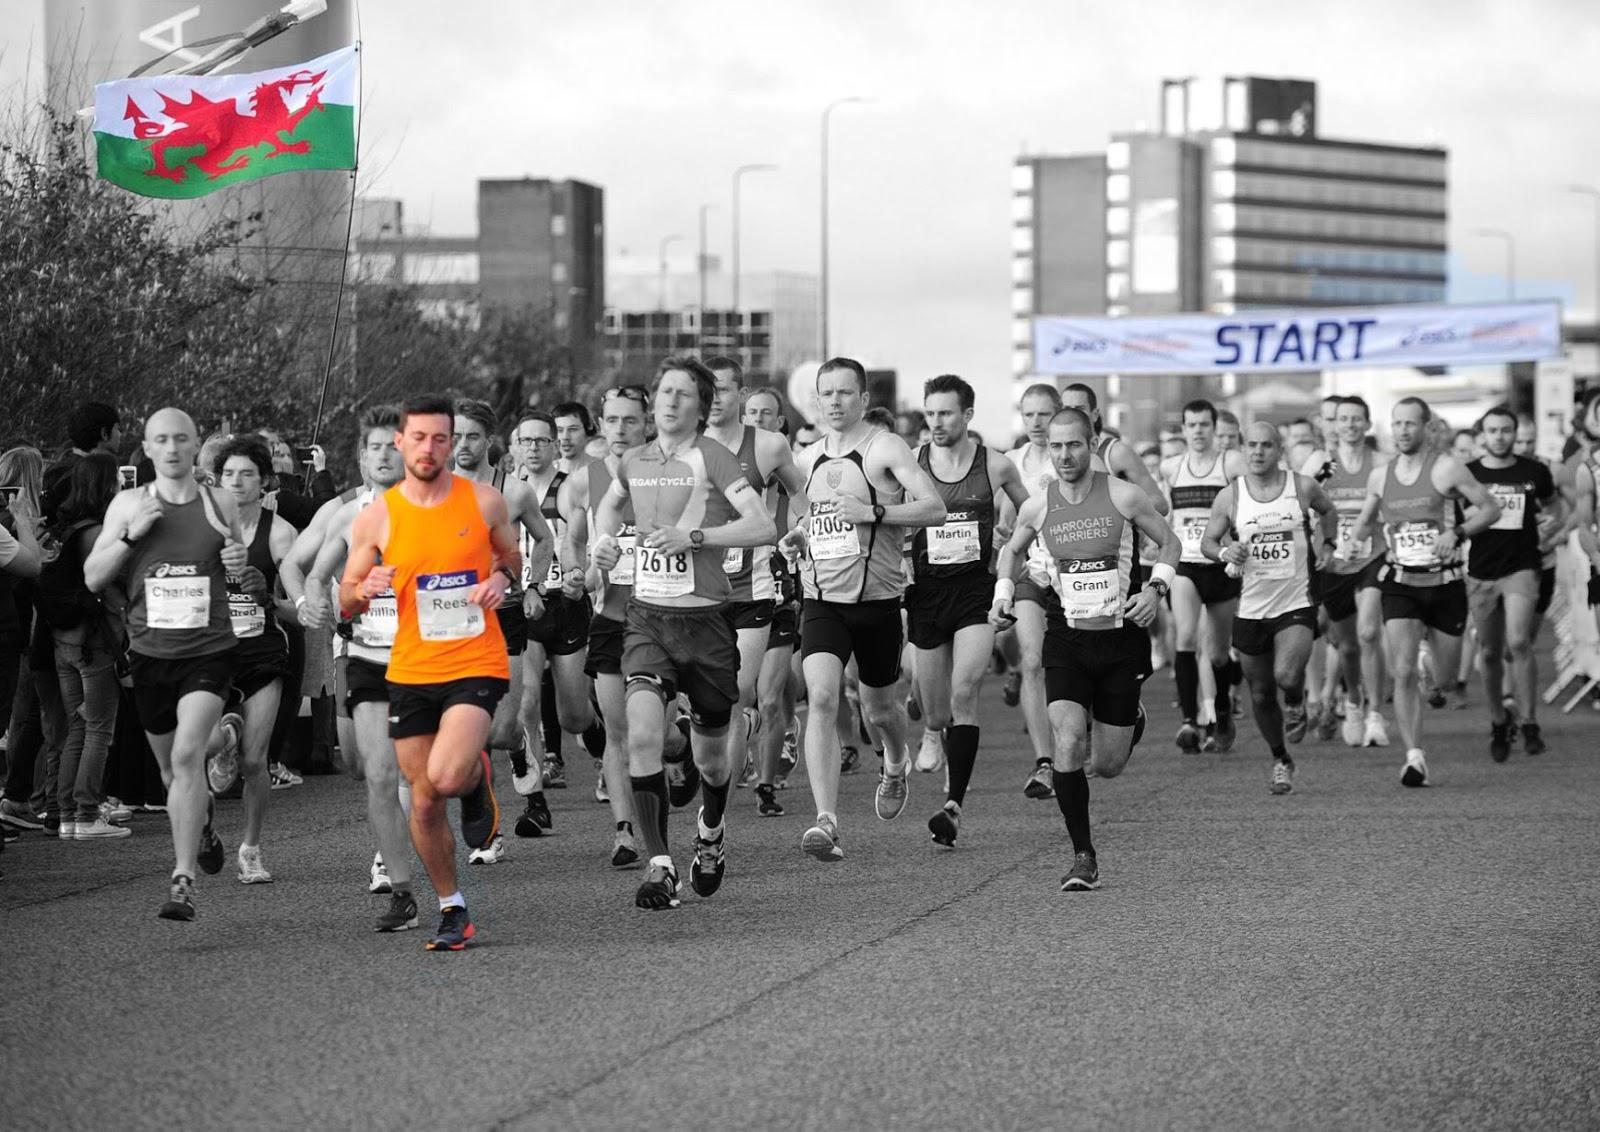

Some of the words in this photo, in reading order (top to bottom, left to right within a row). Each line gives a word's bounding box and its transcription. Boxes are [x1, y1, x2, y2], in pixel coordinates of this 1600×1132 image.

[1214, 318, 1377, 365] START
[1049, 516, 1113, 536] HARROGATE
[935, 528, 972, 539] Martin
[1055, 527, 1109, 545] HARRIERS
[1251, 543, 1290, 560] 4665
[640, 549, 688, 573] 2618
[1080, 561, 1106, 571] asics
[439, 574, 468, 587] asics
[1072, 580, 1109, 592] Grant
[151, 585, 205, 599] Charles
[432, 598, 468, 611] Rees
